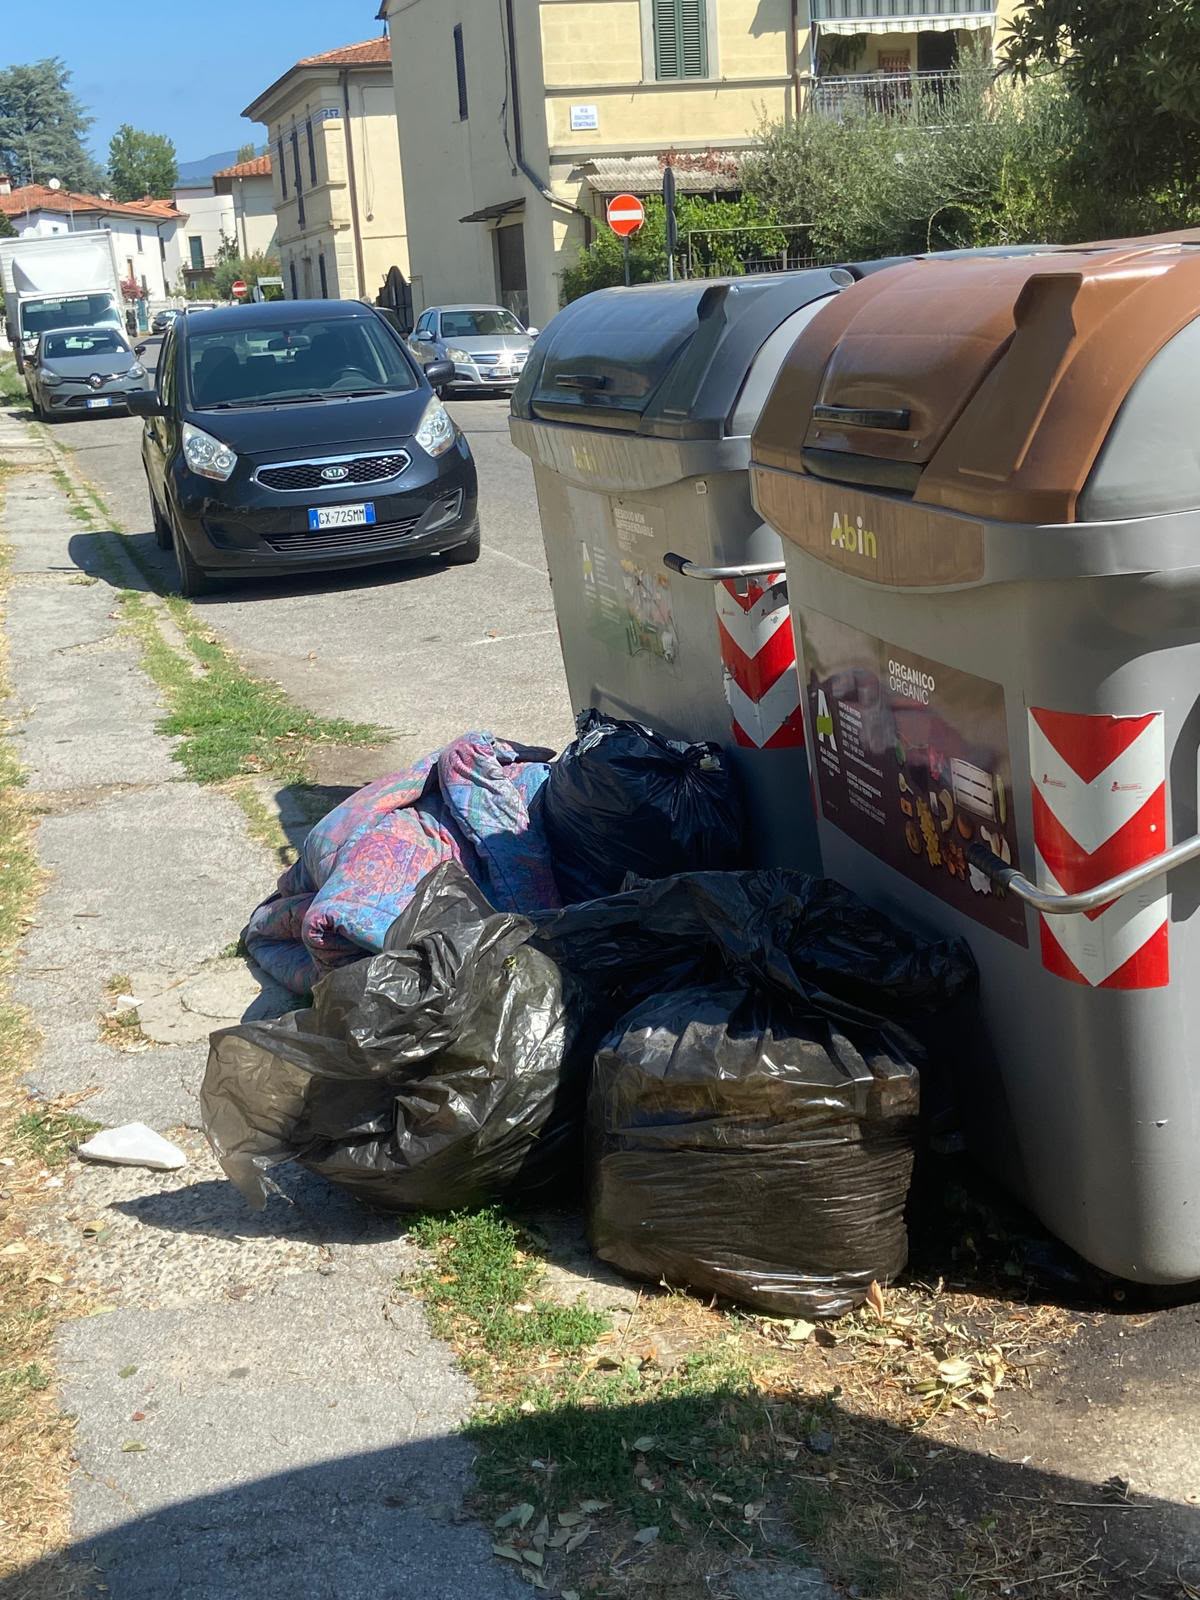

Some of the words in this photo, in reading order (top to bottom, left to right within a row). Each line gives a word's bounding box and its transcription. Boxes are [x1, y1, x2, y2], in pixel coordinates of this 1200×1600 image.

[325, 468, 345, 477] KIA
[831, 511, 877, 559] Abin
[888, 659, 935, 691] ORGANICO
[889, 675, 929, 705] ORGANIC
